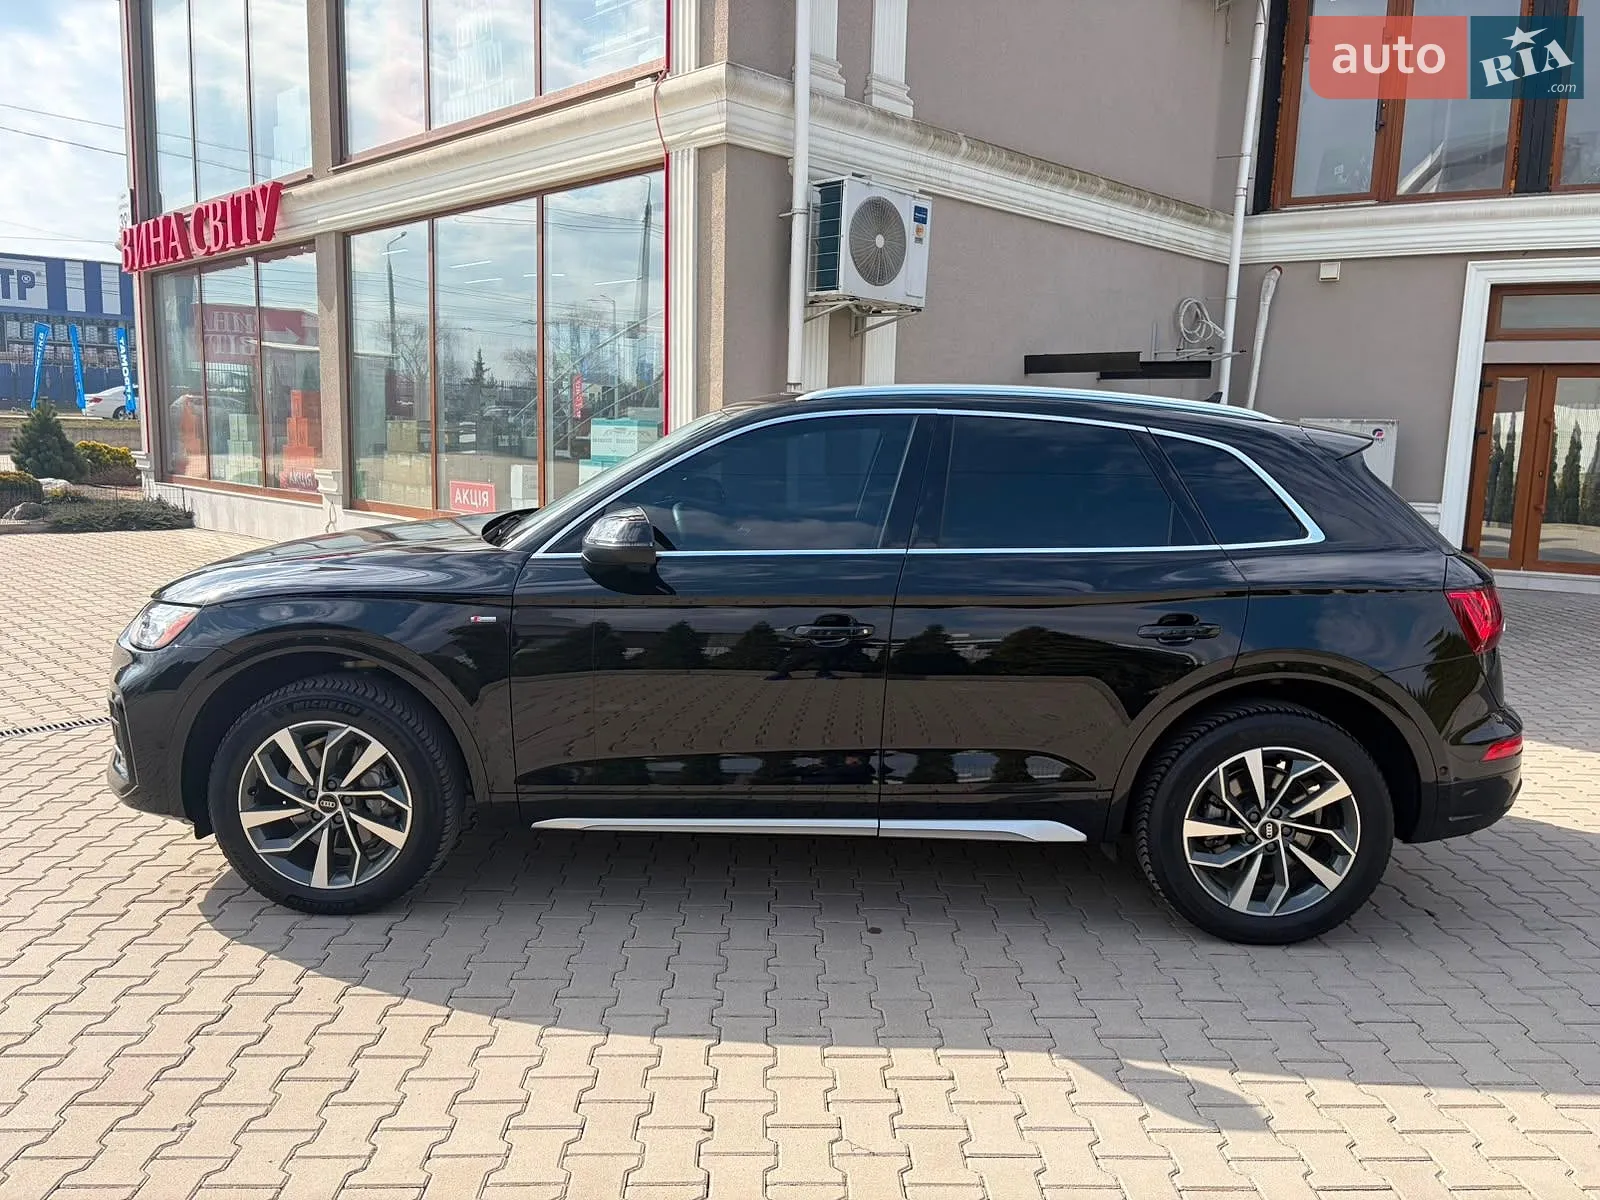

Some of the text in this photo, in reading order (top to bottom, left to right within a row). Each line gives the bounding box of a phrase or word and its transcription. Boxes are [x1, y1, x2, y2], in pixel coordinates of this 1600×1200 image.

[121, 212, 192, 273] ВИНА
[189, 181, 283, 257] СВІТУ
[454, 487, 489, 508] АКЦІЯ
